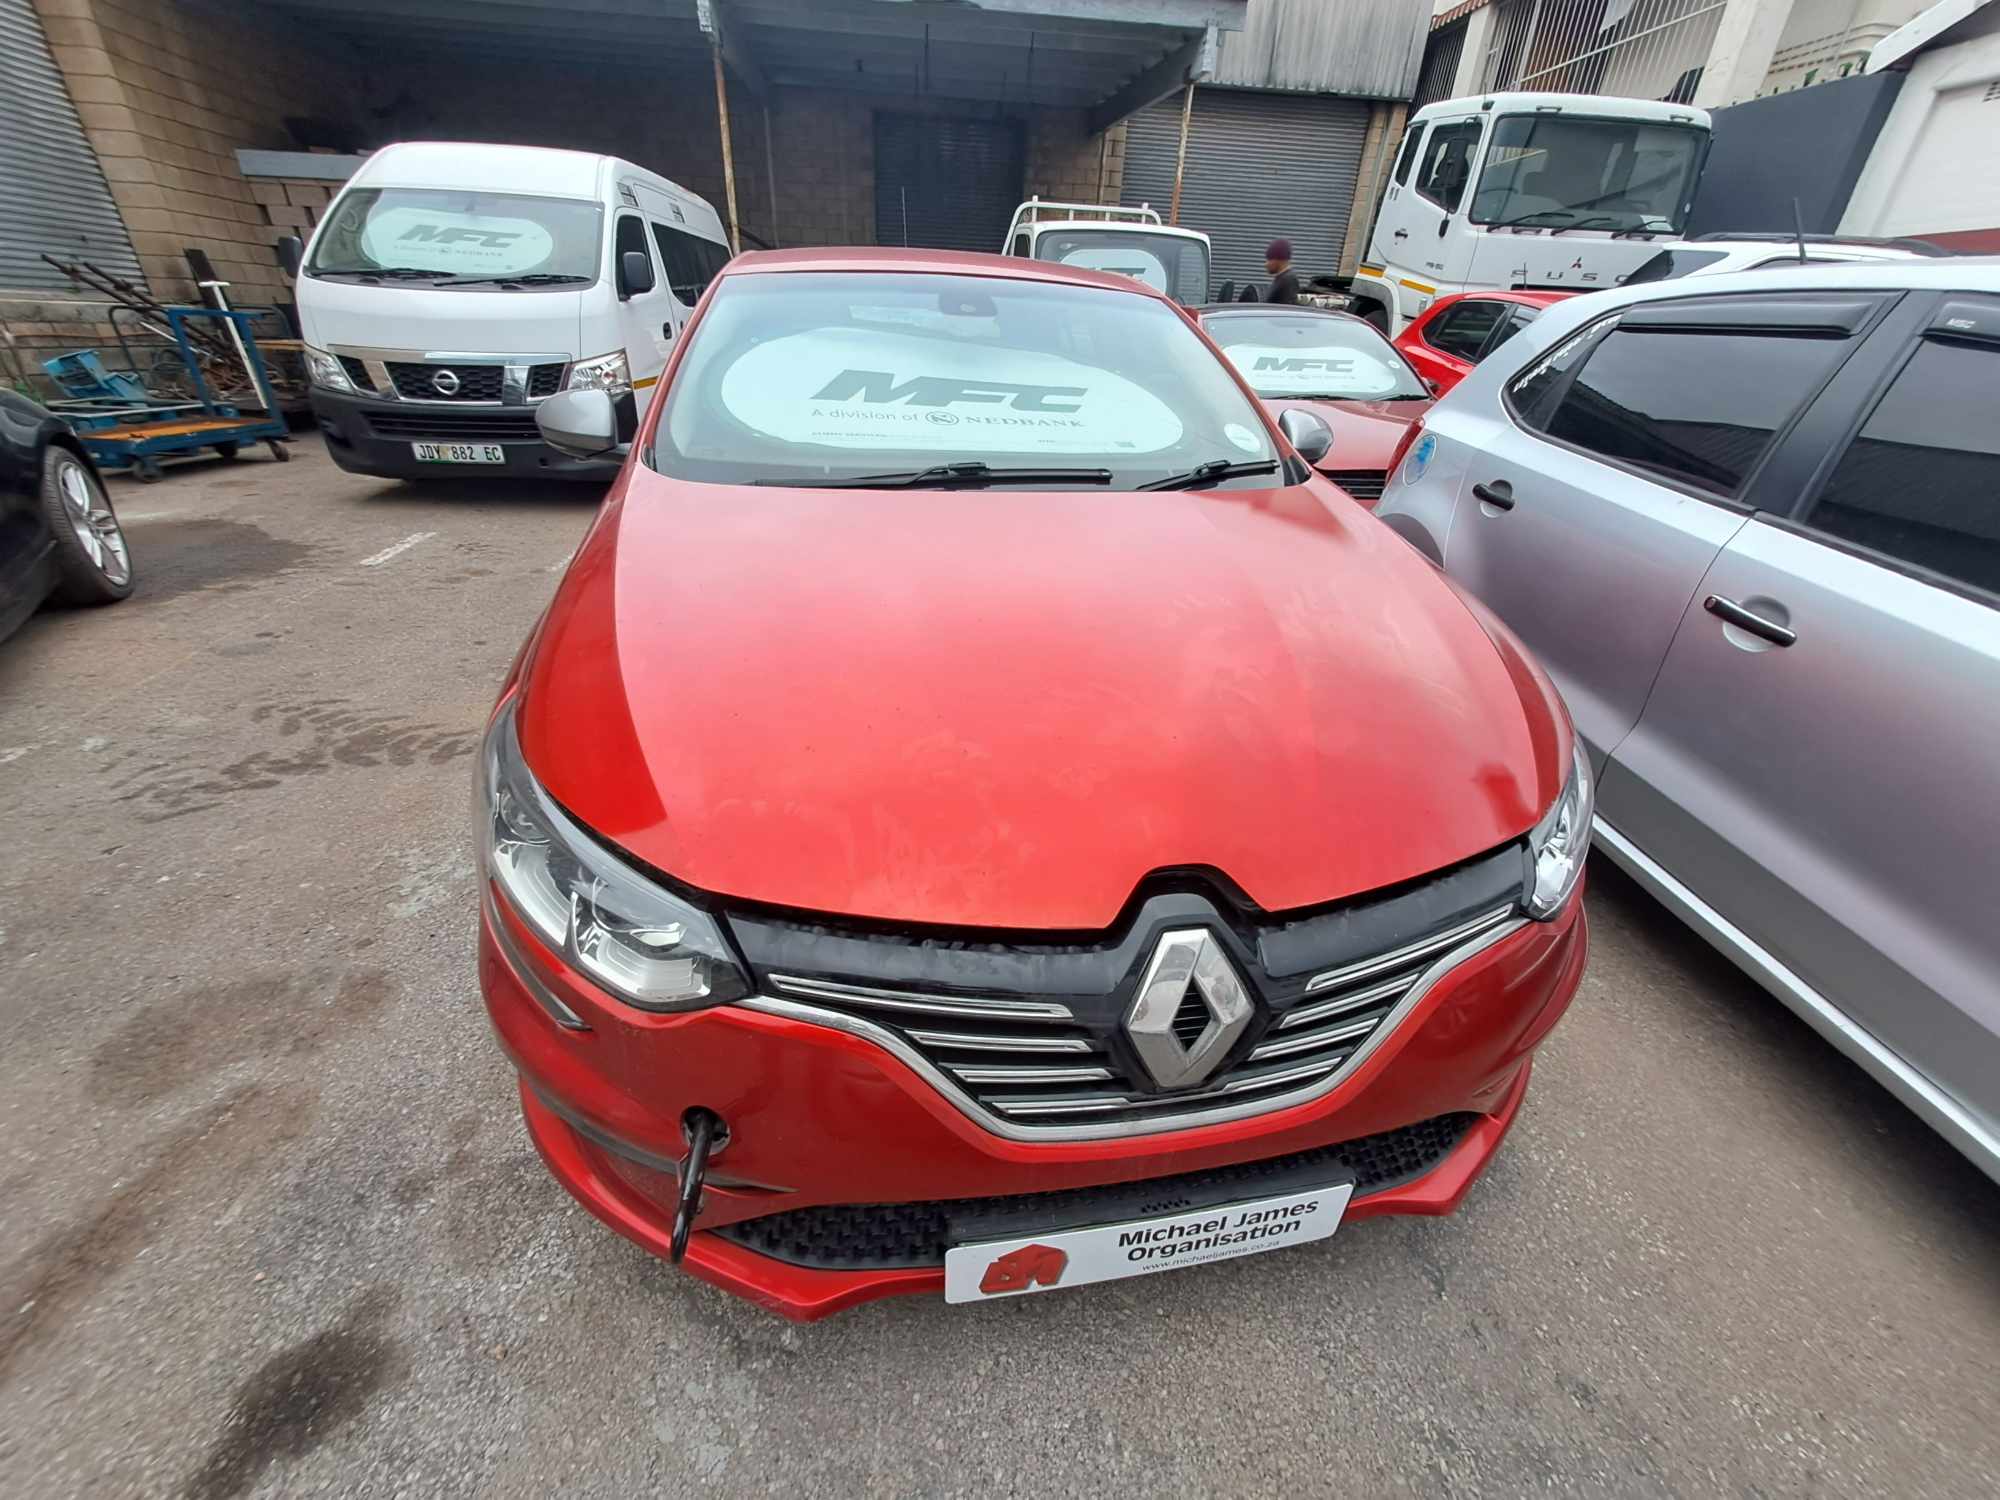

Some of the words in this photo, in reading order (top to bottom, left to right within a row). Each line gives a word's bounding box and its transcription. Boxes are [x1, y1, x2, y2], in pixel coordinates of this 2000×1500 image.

[397, 224, 523, 249] MFC
[1252, 356, 1355, 373] MFC
[808, 368, 1089, 413] MFC
[811, 408, 823, 417] A
[829, 407, 896, 421] division
[902, 412, 919, 422] of
[965, 415, 1087, 428] NEDBANK
[419, 444, 441, 459] JDY
[451, 445, 477, 460] 882
[483, 446, 501, 461] EC
[1118, 1216, 1227, 1247] Michael
[1232, 1200, 1319, 1228] James
[1127, 1220, 1301, 1262] Organisation
